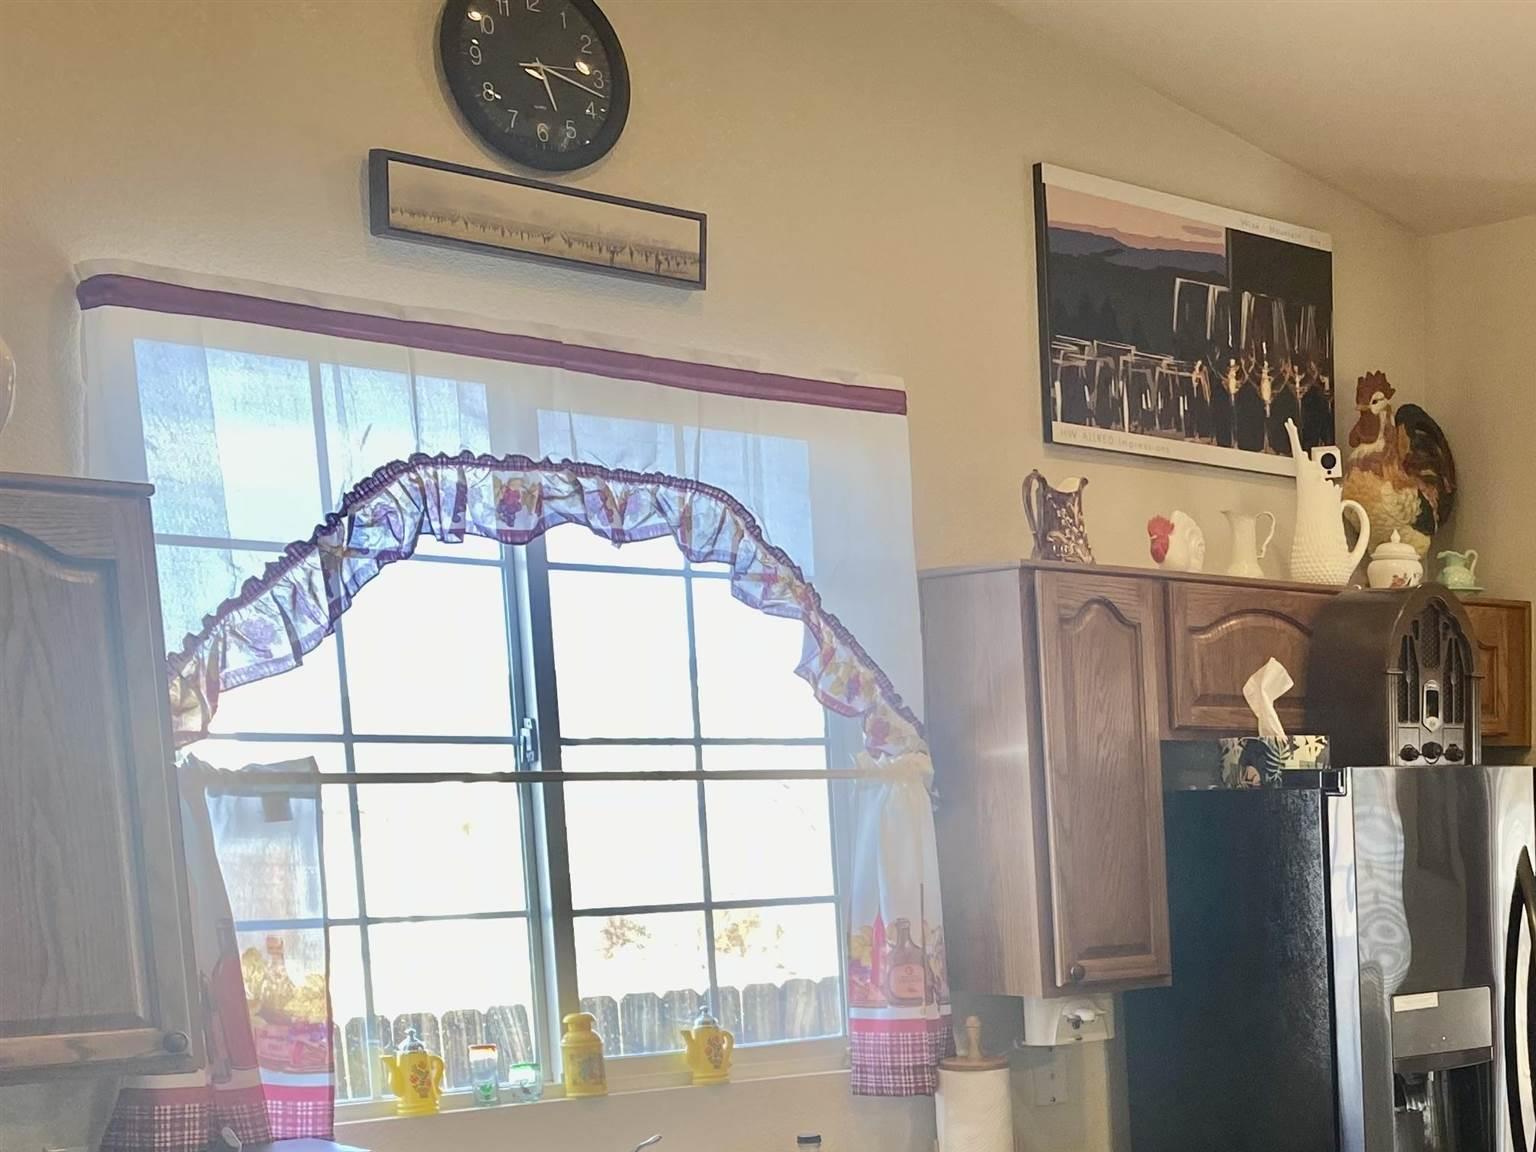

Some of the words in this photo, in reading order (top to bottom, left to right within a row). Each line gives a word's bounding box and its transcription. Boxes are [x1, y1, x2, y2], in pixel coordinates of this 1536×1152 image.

[497, 0, 509, 17] 11
[560, 11, 567, 30] 1
[580, 34, 592, 54] 2
[469, 44, 482, 65] 9
[592, 69, 605, 89] 3
[482, 81, 495, 101] 8
[507, 109, 519, 129] 7
[585, 101, 597, 119] 4
[536, 122, 549, 142] 6
[565, 119, 577, 139] 5
